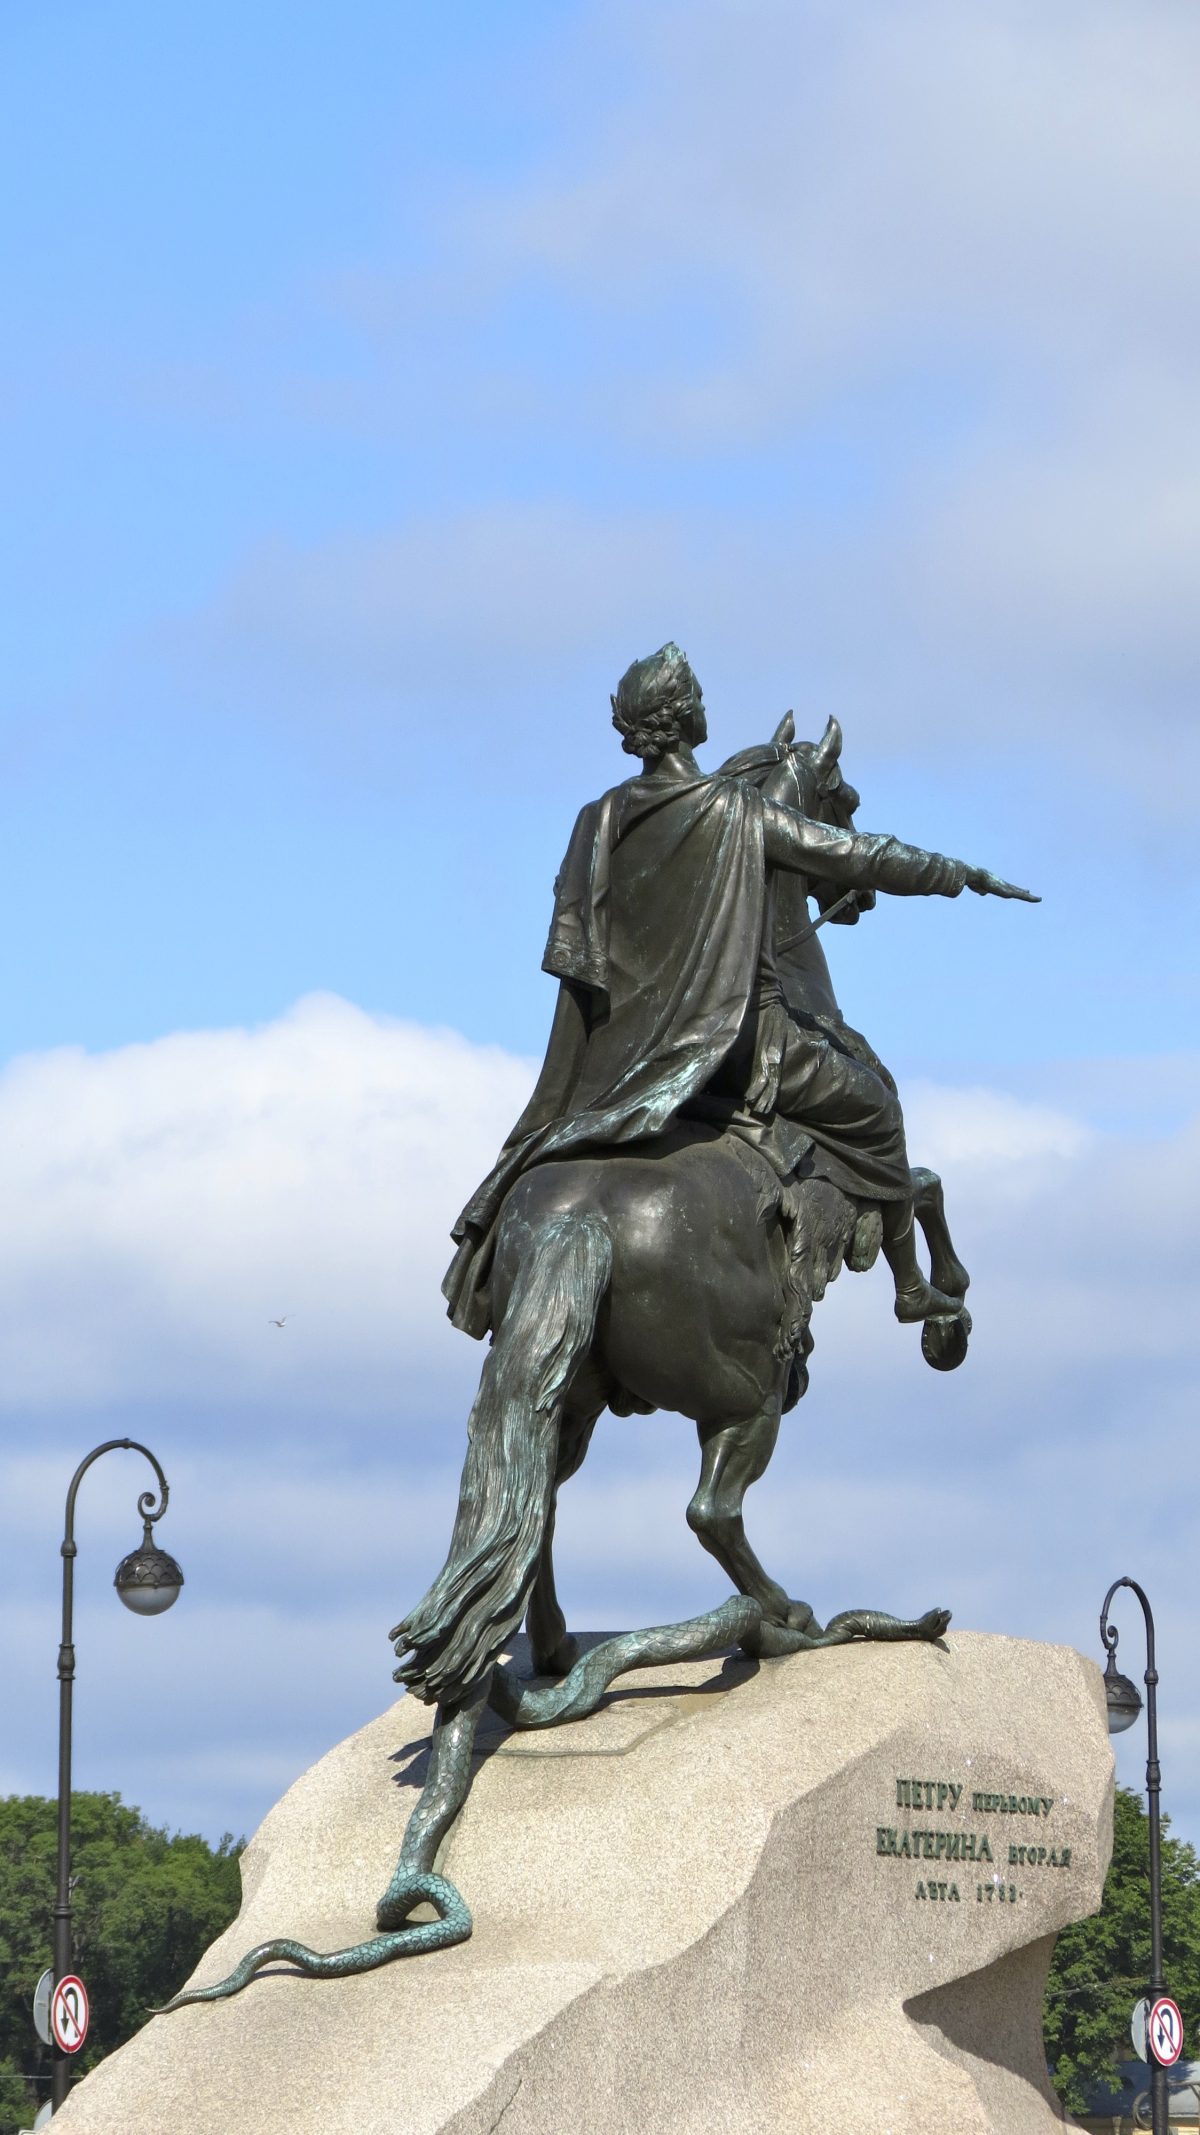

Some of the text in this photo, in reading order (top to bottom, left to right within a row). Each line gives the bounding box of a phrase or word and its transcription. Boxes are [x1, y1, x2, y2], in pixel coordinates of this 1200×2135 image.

[896, 1779, 963, 1811] ПЕТРУ
[876, 1827, 1072, 1868] ЕКАТЕРИНА ВТОРАЯ
